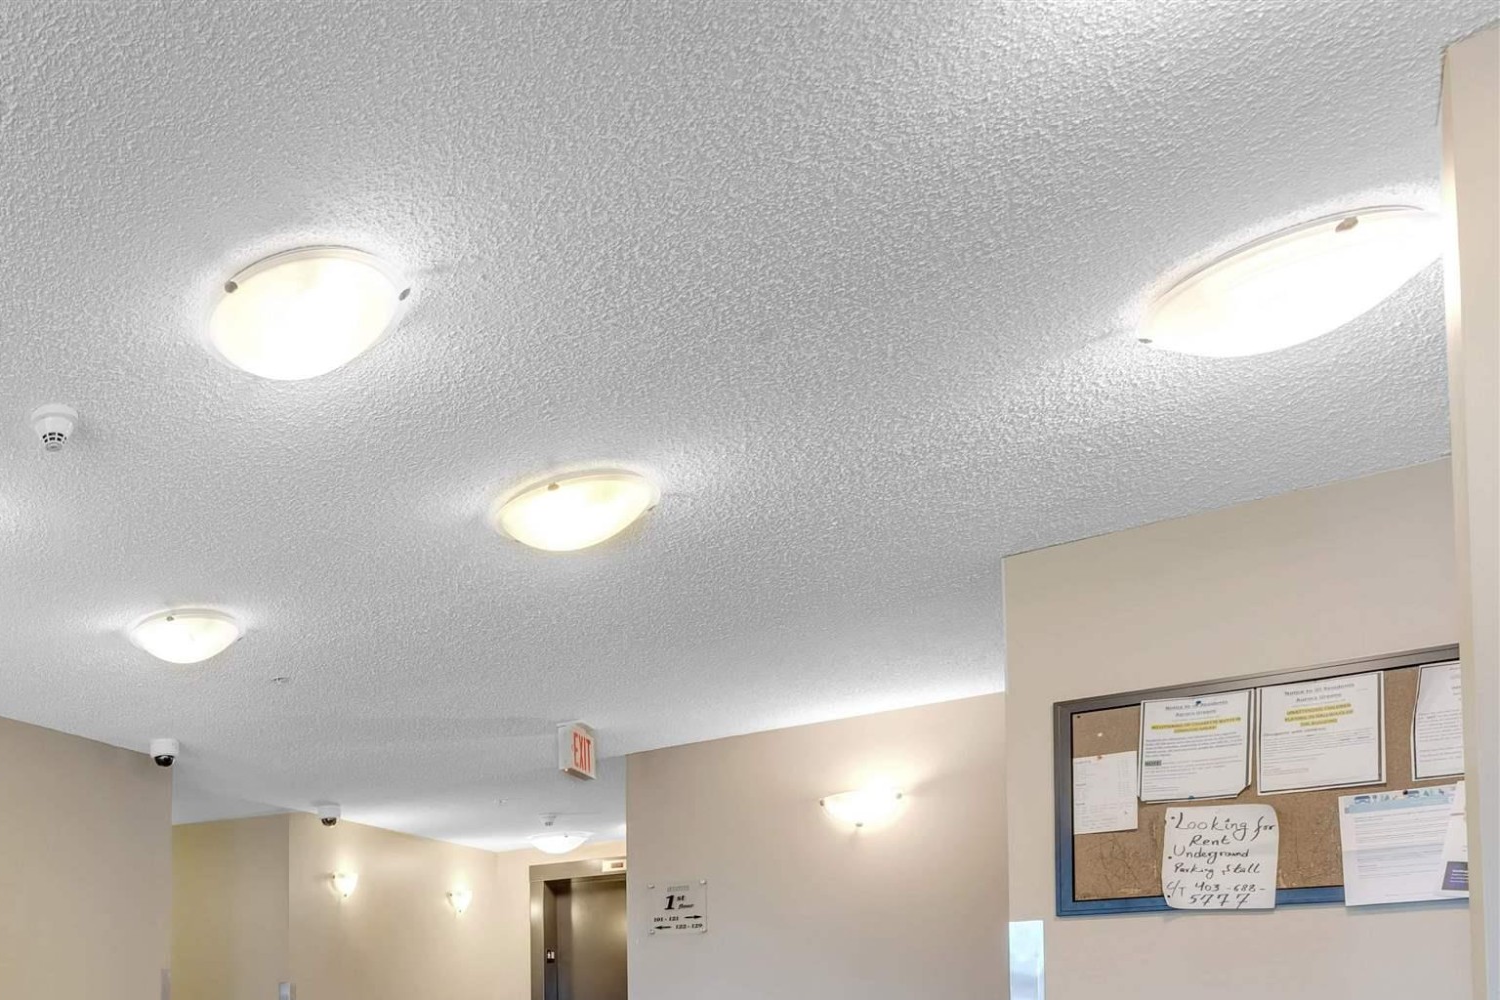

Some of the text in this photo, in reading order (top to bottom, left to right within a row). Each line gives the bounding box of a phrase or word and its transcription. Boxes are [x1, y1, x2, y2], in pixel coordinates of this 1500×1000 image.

[573, 732, 591, 773] EXIT
[1175, 812, 1276, 841] Looking for
[1189, 834, 1231, 847] Rent
[1173, 844, 1250, 865] Underground
[1174, 862, 1214, 880] Parking
[1189, 893, 1250, 909] 5777
